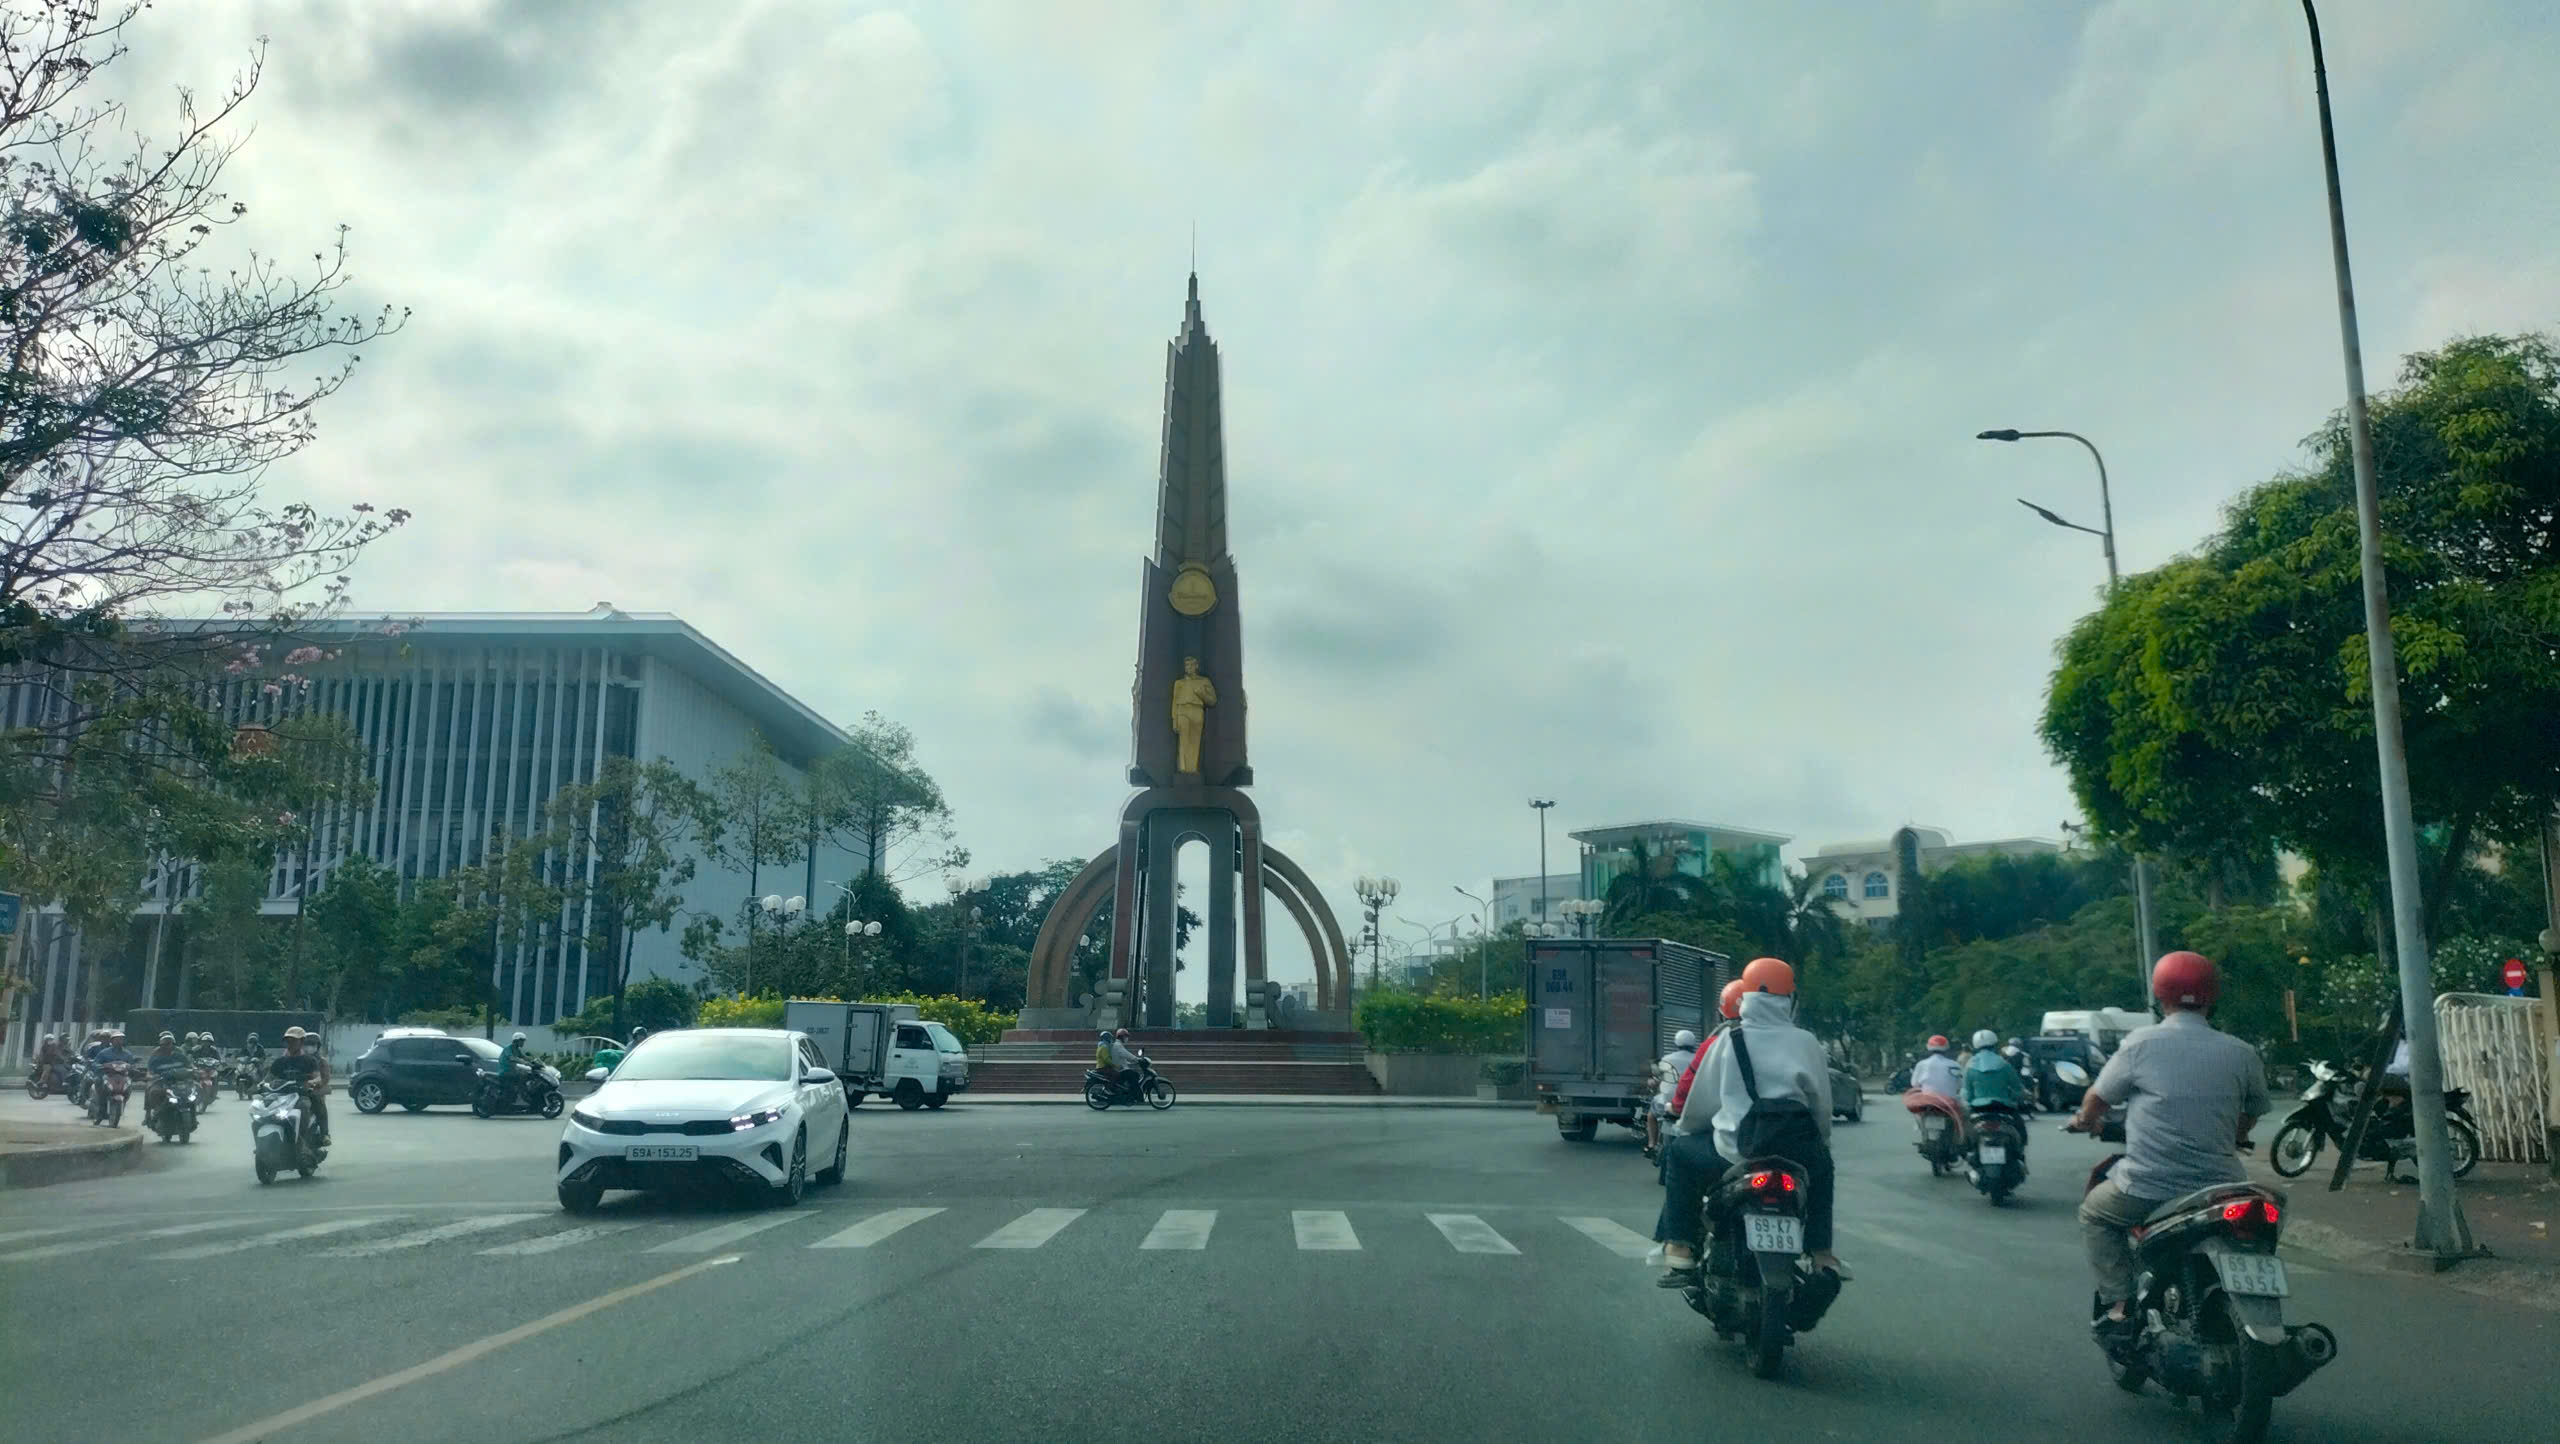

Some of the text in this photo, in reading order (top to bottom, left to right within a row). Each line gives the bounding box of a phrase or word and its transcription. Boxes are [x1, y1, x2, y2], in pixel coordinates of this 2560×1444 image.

[632, 1147, 692, 1158] 69A-153.25
[1756, 1233, 1794, 1249] 2389
[2231, 1274, 2280, 1294] 6954
